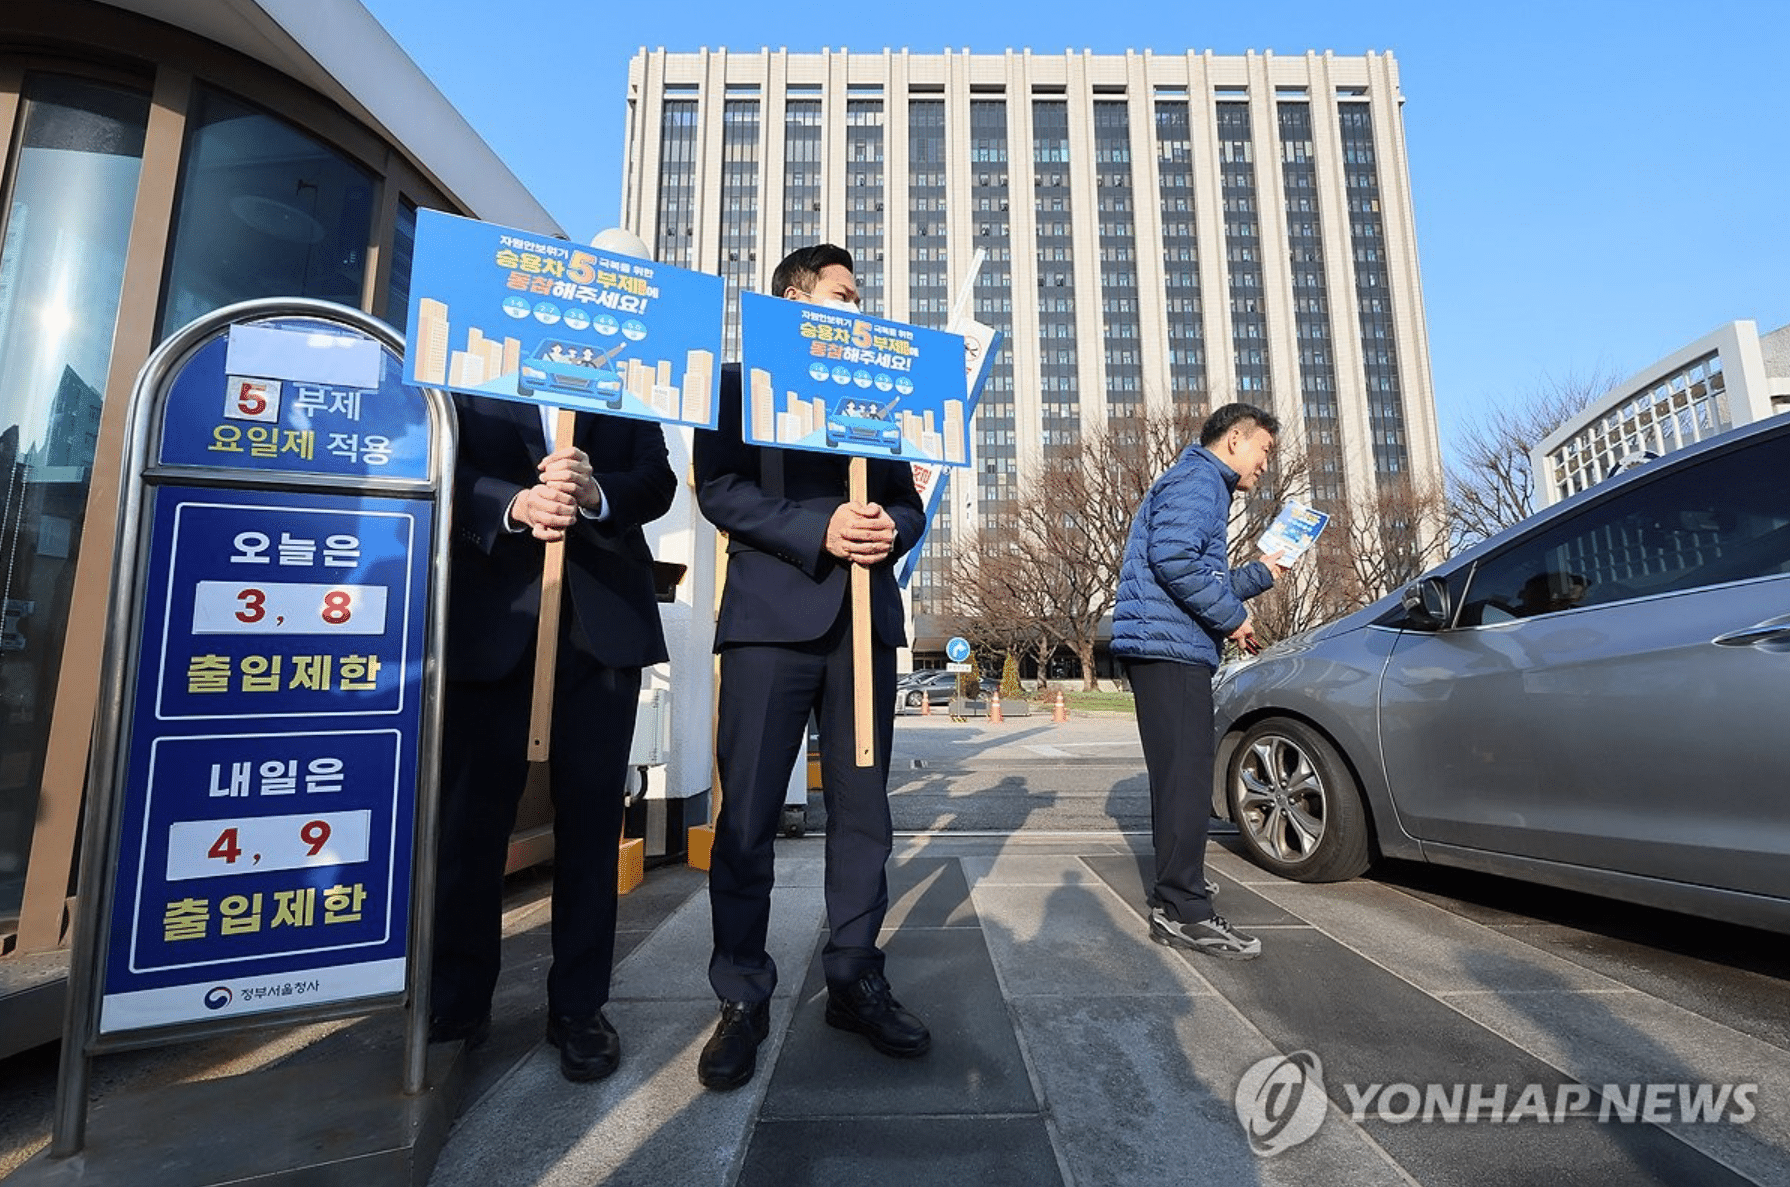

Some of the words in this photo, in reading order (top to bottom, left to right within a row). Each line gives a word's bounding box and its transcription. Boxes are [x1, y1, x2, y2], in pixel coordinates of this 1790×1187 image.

[237, 382, 267, 416] 5
[207, 424, 315, 461] 요일제
[327, 431, 393, 466] 적용
[230, 531, 361, 568] 오늘은
[321, 591, 352, 625] 8
[187, 653, 381, 694] 출입제한
[209, 756, 345, 798] 내일은
[300, 819, 332, 857] 9
[162, 882, 367, 942] 출입제한
[240, 979, 320, 1002] 정부서울청사
